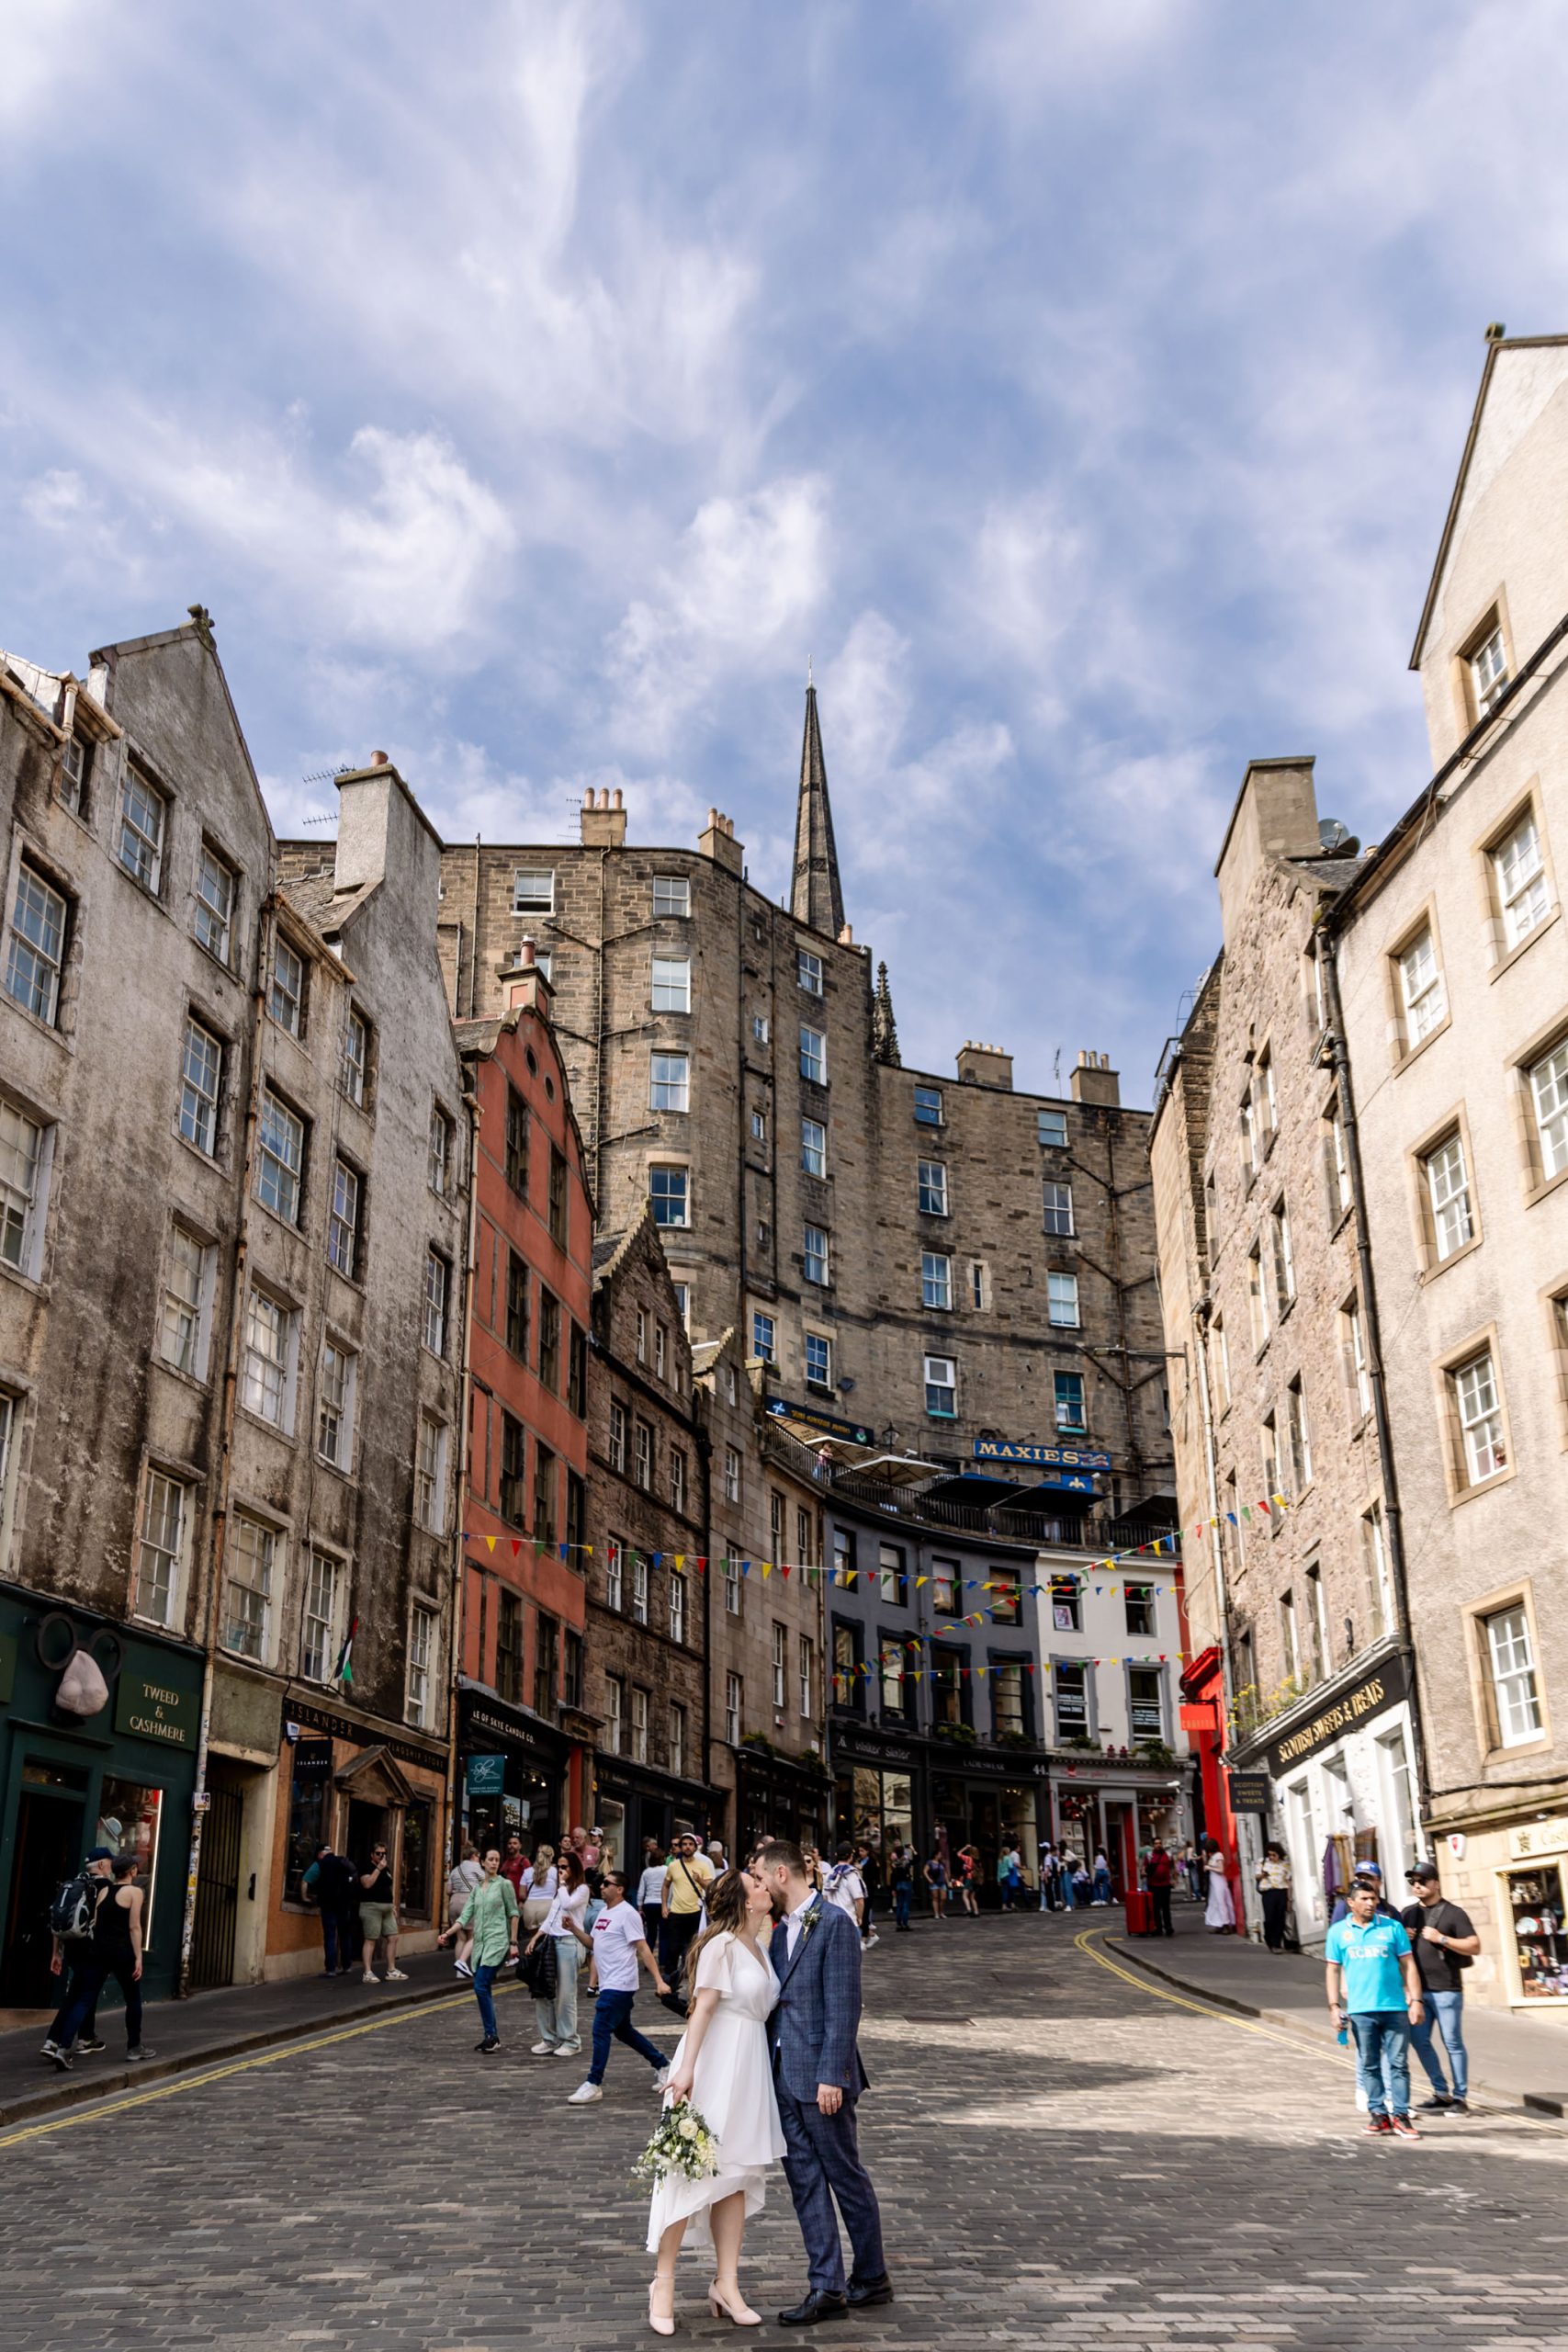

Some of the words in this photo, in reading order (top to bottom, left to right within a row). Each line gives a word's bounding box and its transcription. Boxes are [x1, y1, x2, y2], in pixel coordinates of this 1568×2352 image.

[978, 1442, 1079, 1465] MAXIES
[142, 1683, 179, 1706] TWEED
[154, 1705, 164, 1719] &
[290, 1702, 353, 1737] ISLANDER
[1278, 1726, 1314, 1763] SCOTTISH
[1313, 1706, 1344, 1742] SWEETS
[1343, 1701, 1353, 1721] &
[1350, 1678, 1384, 1717] TREATS
[130, 1715, 186, 1742] CASHMERE
[480, 1713, 490, 1723] OF
[490, 1716, 504, 1730] SKYE
[504, 1724, 525, 1740] CANDLE
